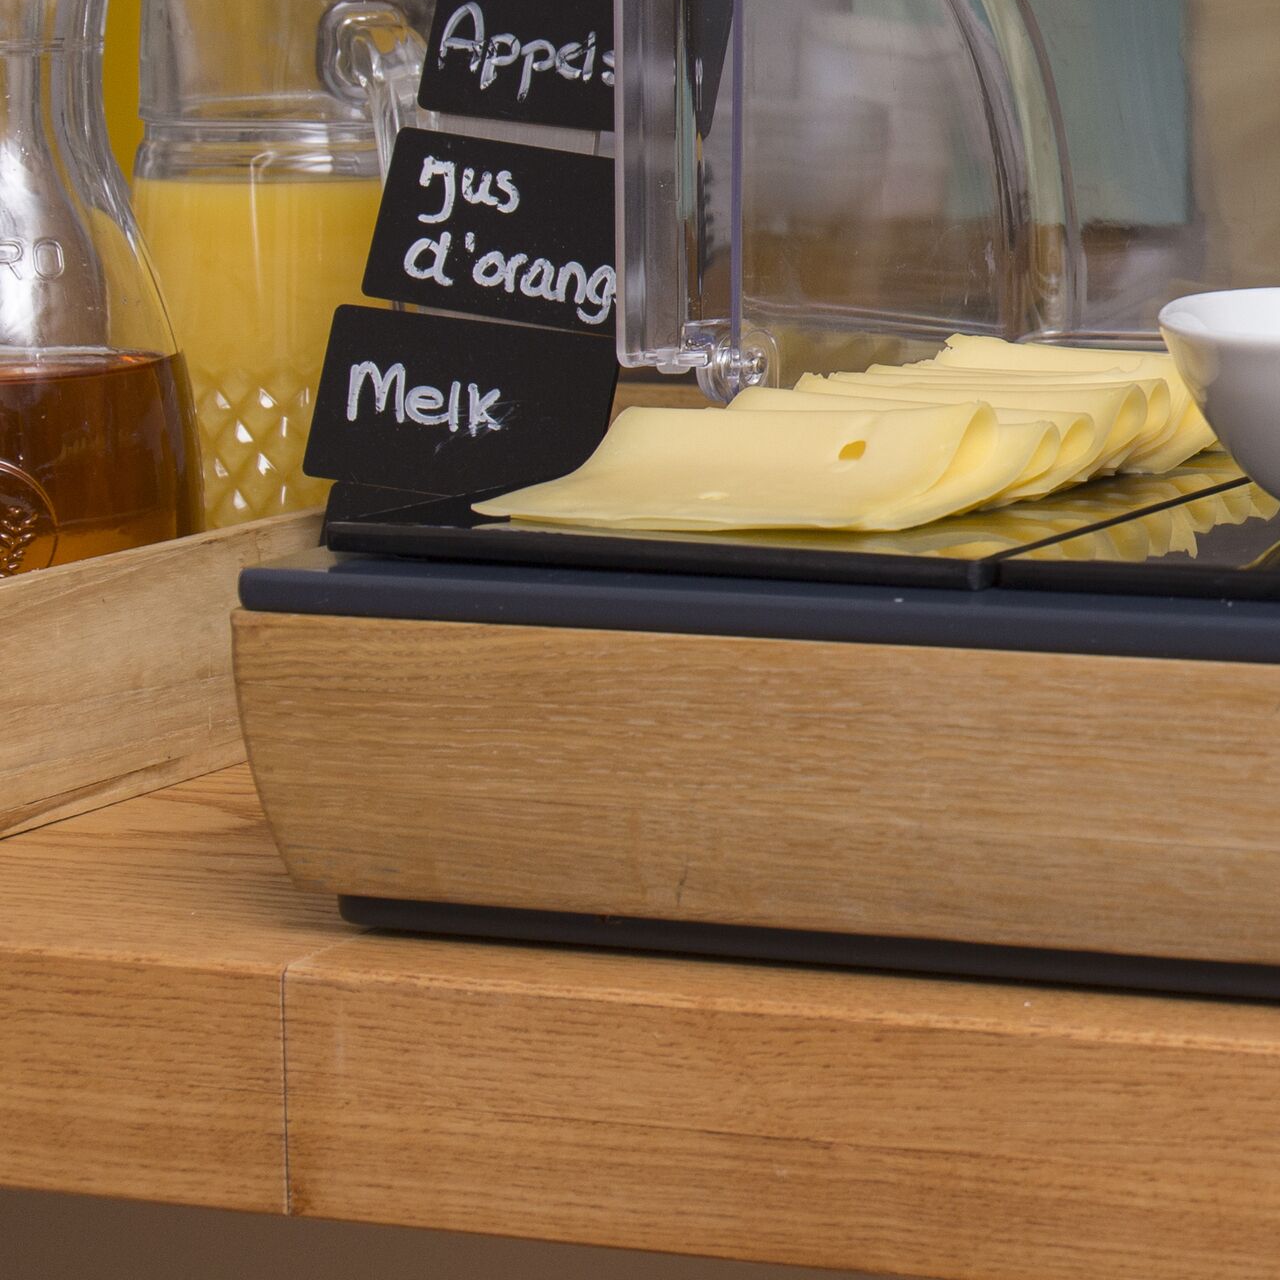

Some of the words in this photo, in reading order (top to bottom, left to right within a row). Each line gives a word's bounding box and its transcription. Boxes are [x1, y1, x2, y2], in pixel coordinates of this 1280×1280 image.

[418, 156, 520, 223] Jus
[404, 232, 616, 325] d'orang
[347, 361, 502, 437] Melk
